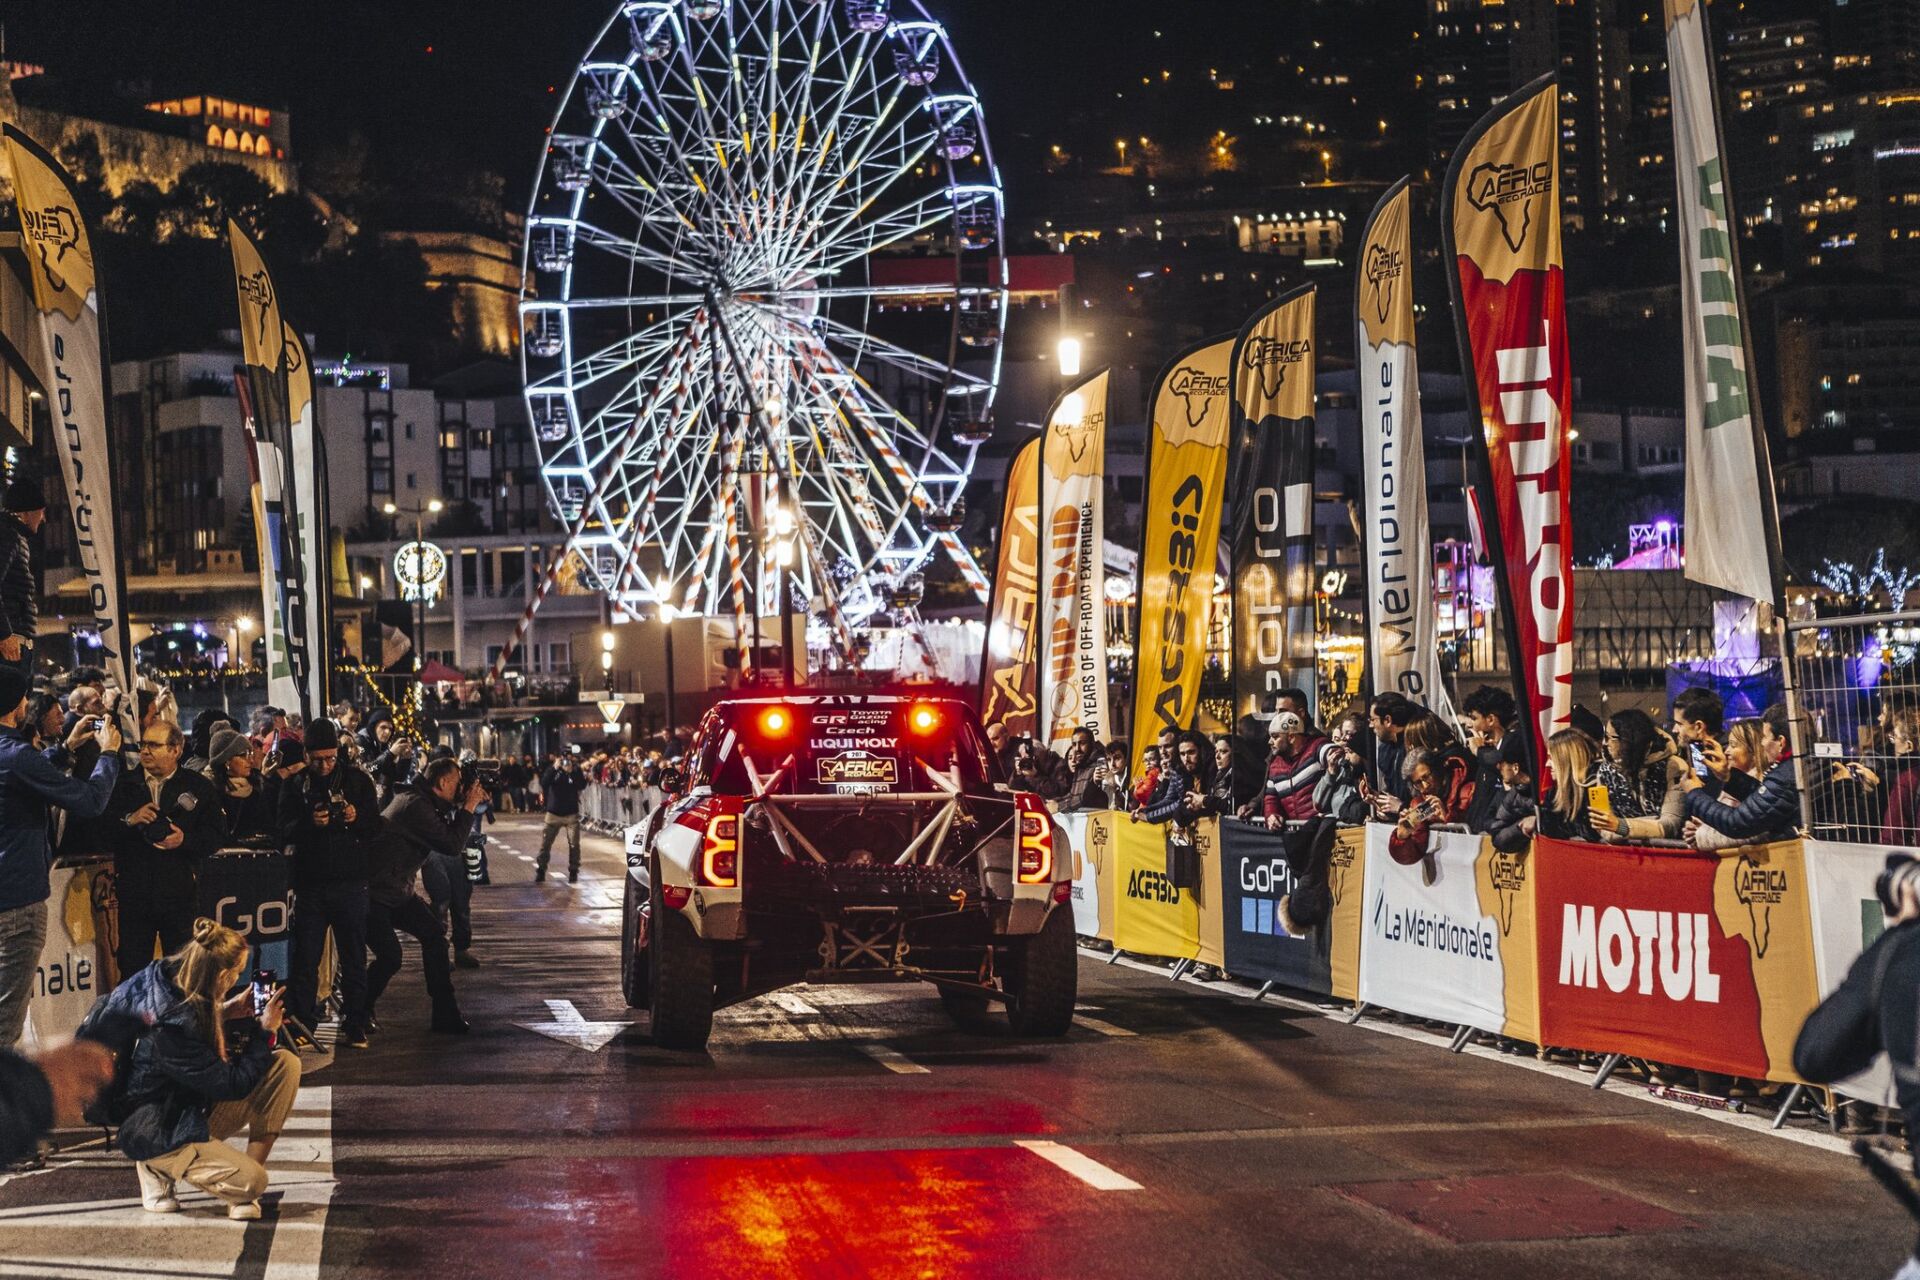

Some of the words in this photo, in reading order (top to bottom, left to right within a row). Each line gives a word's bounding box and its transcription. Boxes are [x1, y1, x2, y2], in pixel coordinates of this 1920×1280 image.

[1377, 360, 1417, 656] Méridionale
[1080, 500, 1094, 583] EXPERIENCE
[1081, 585, 1094, 649] OFF-ROAD
[1083, 651, 1095, 674] OF
[1084, 678, 1098, 719] YEARS
[812, 715, 847, 724] GR
[810, 738, 853, 749] LIQUI
[855, 738, 898, 748] MOLY
[831, 760, 894, 774] AFRICA
[1493, 860, 1526, 883] AFRICA
[1740, 870, 1787, 896] AFRICA
[1384, 906, 1401, 942] La
[1403, 907, 1494, 964] Méridionale
[1559, 903, 1721, 1004] MOTUL
